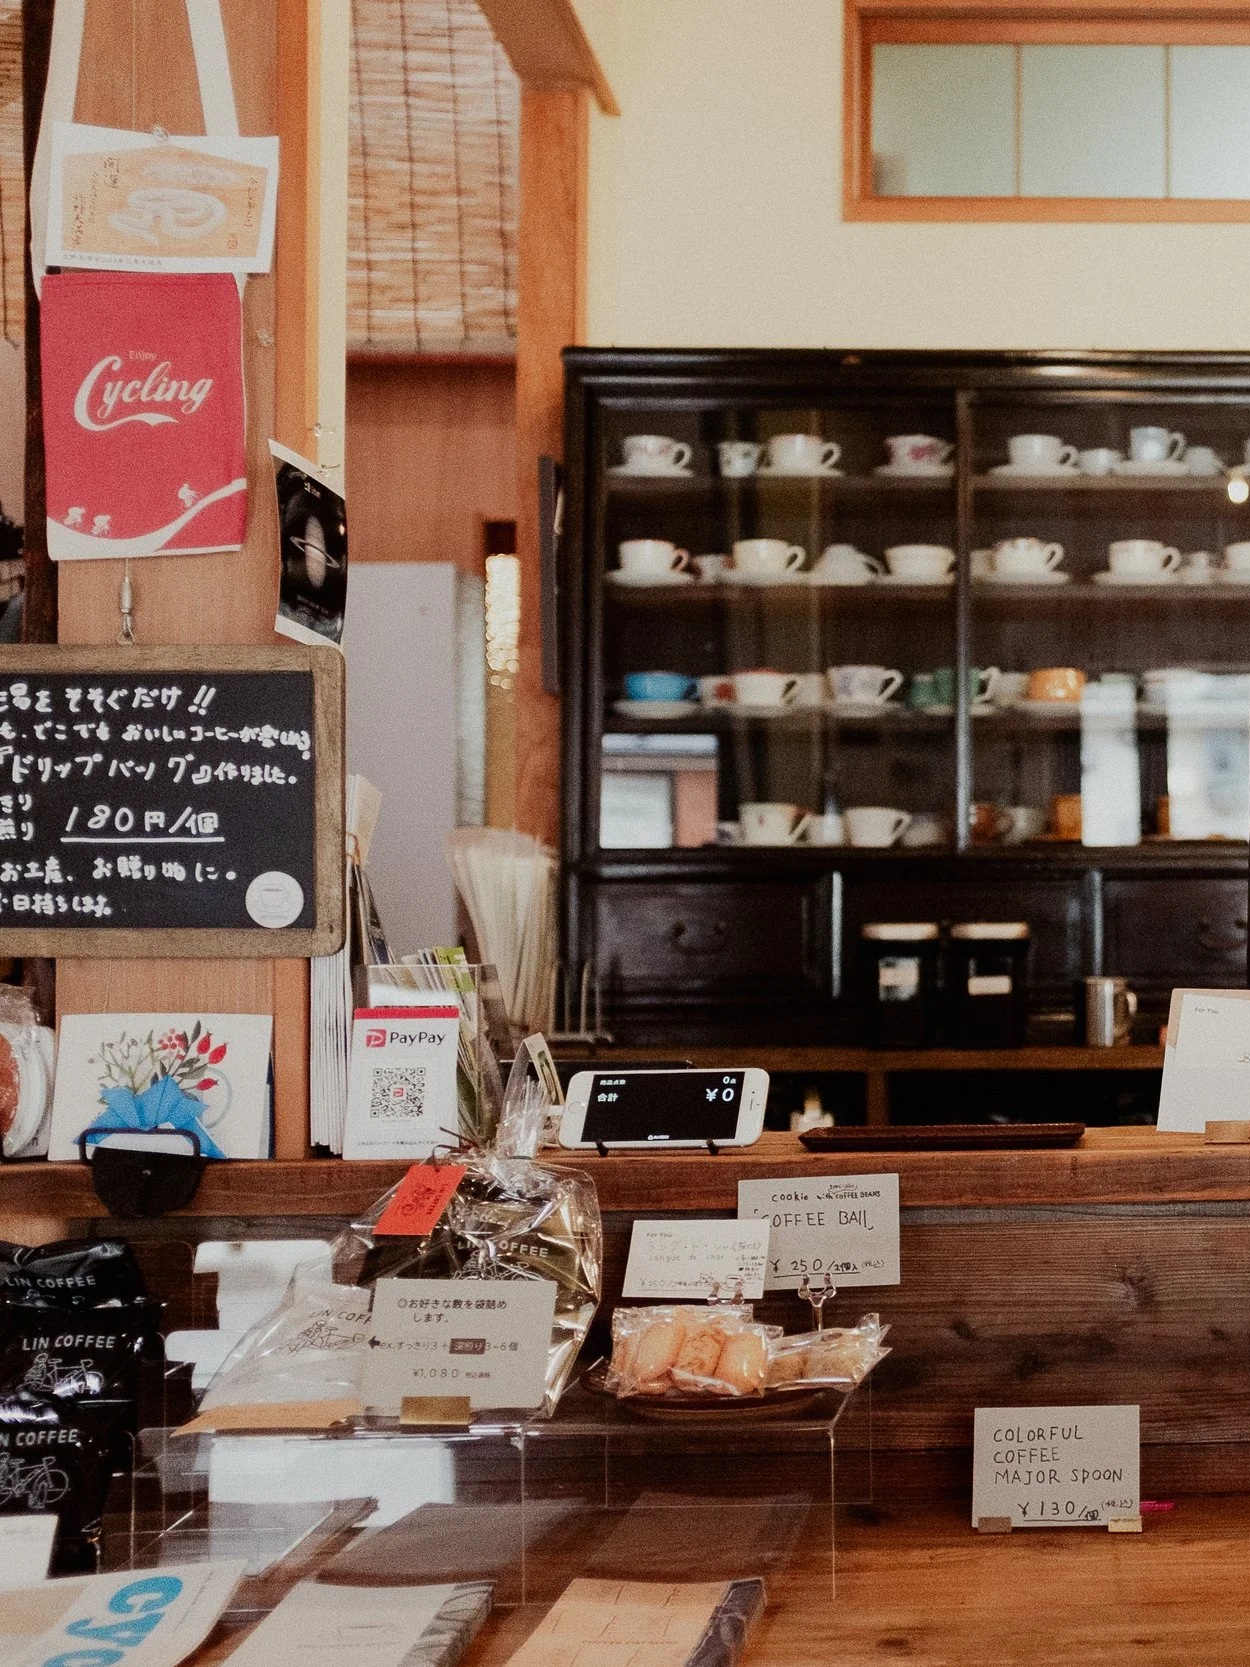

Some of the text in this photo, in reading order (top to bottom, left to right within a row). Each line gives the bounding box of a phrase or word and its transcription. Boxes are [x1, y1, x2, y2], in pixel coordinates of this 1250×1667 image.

[74, 355, 213, 431] Cycling
[390, 1031, 446, 1046] PayPay
[771, 1191, 809, 1202] cookie
[497, 1240, 549, 1258] OFFEE
[6, 1275, 97, 1288] LIN COFFEE
[337, 1311, 372, 1325] COFF
[413, 1312, 449, 1323] します。
[22, 1334, 117, 1351] LIN COFFEE
[16, 1429, 80, 1446] COFFEE
[993, 1425, 1083, 1443] COLORFUL
[993, 1447, 1060, 1464] COFFEE
[995, 1468, 1123, 1485] MAJOR SPOON
